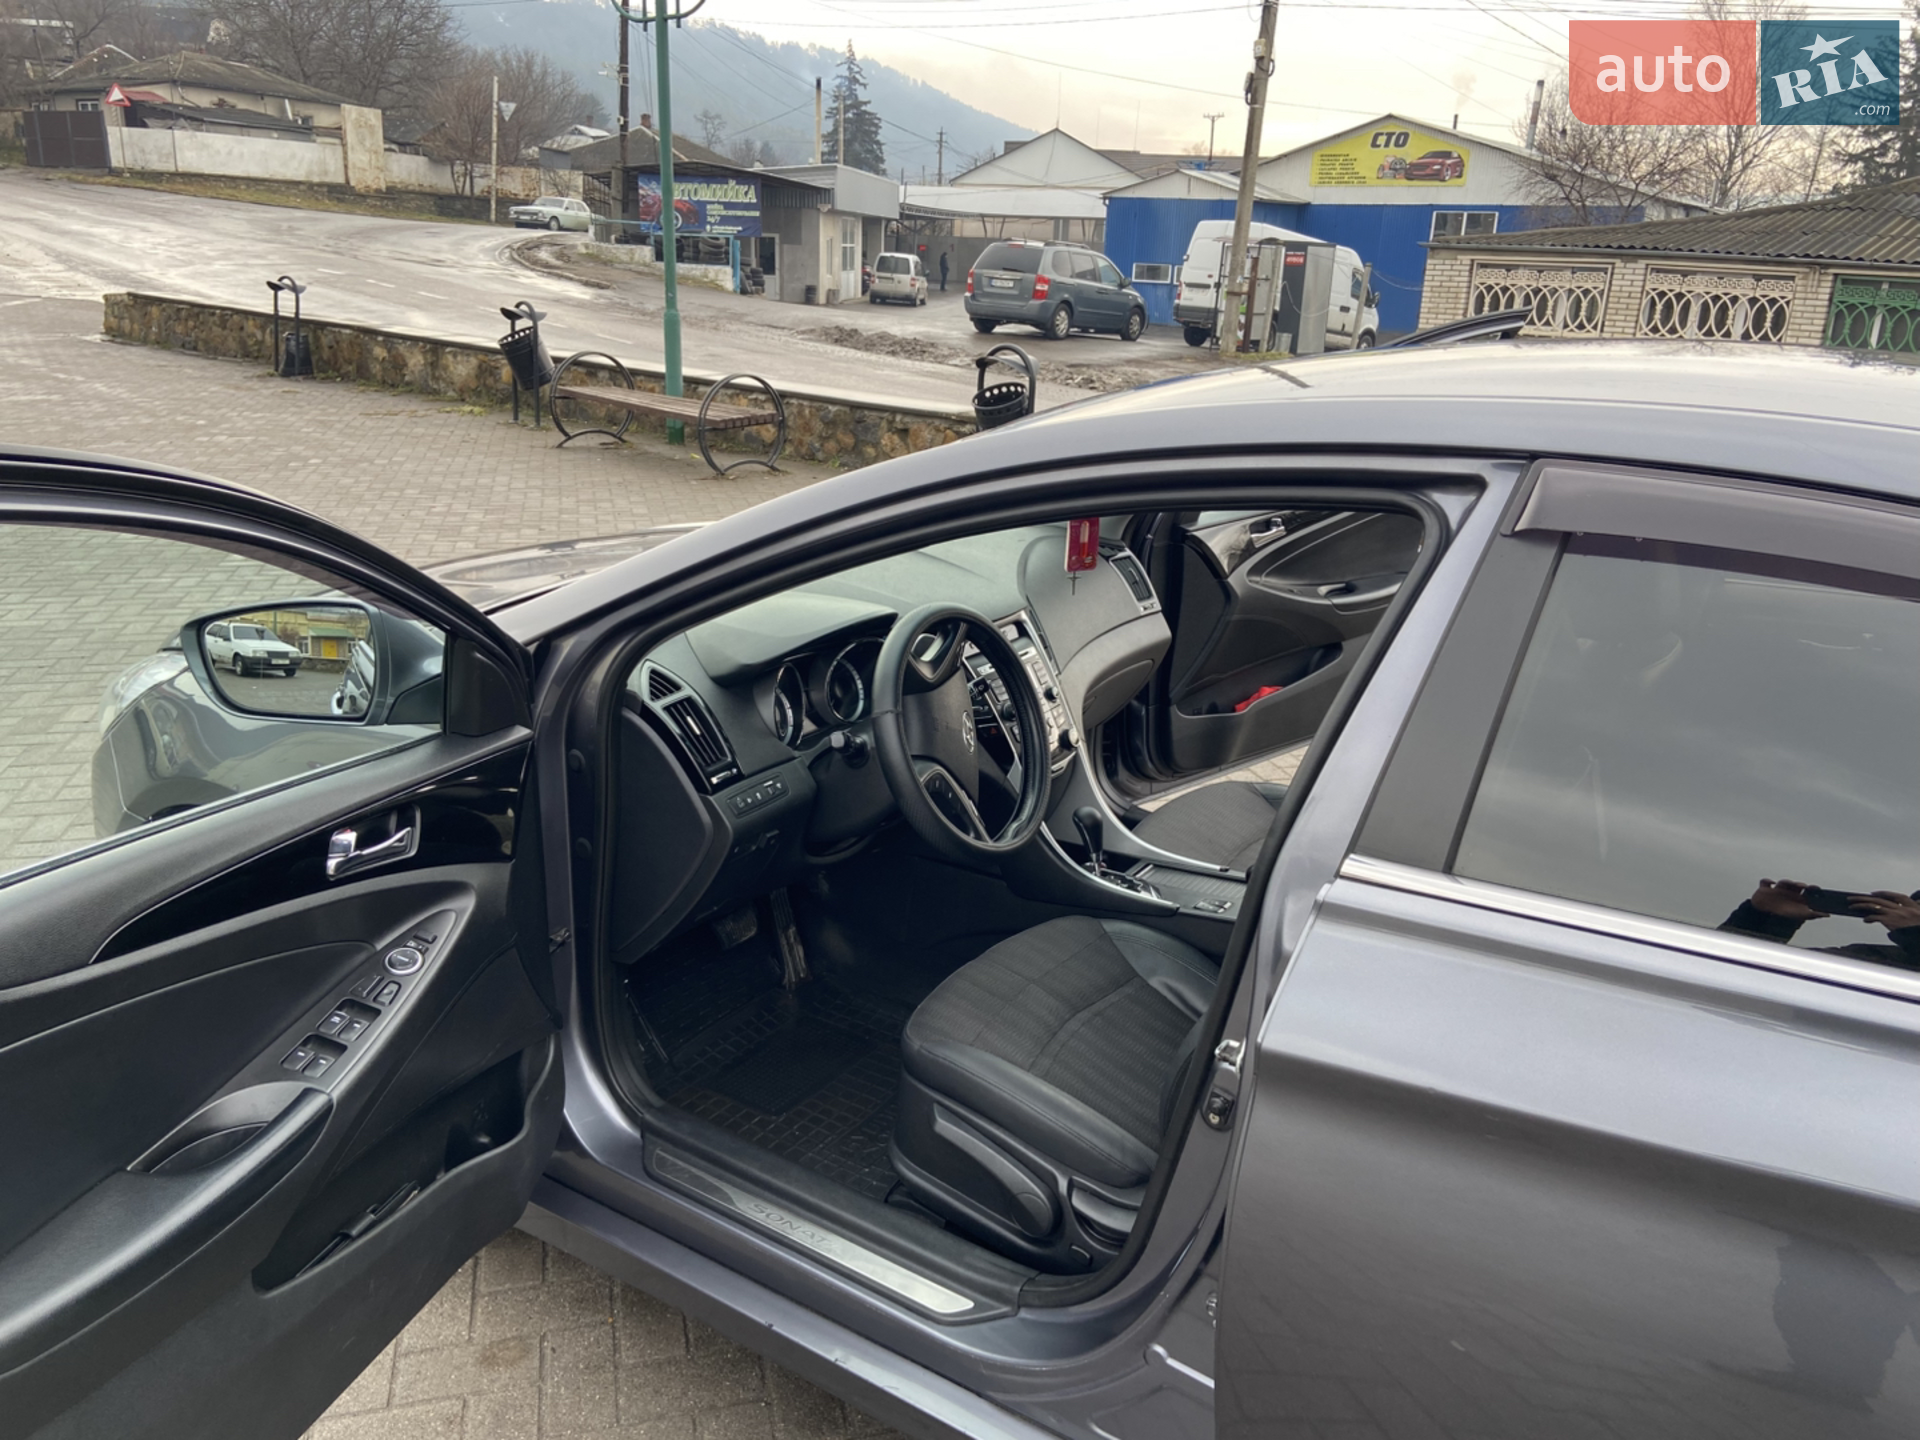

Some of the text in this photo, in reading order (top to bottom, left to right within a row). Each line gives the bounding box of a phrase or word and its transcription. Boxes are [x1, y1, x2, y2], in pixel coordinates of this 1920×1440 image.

[1370, 131, 1410, 149] СТО
[673, 180, 757, 202] ВТОМИЙКА
[747, 1202, 836, 1250] SONAT
